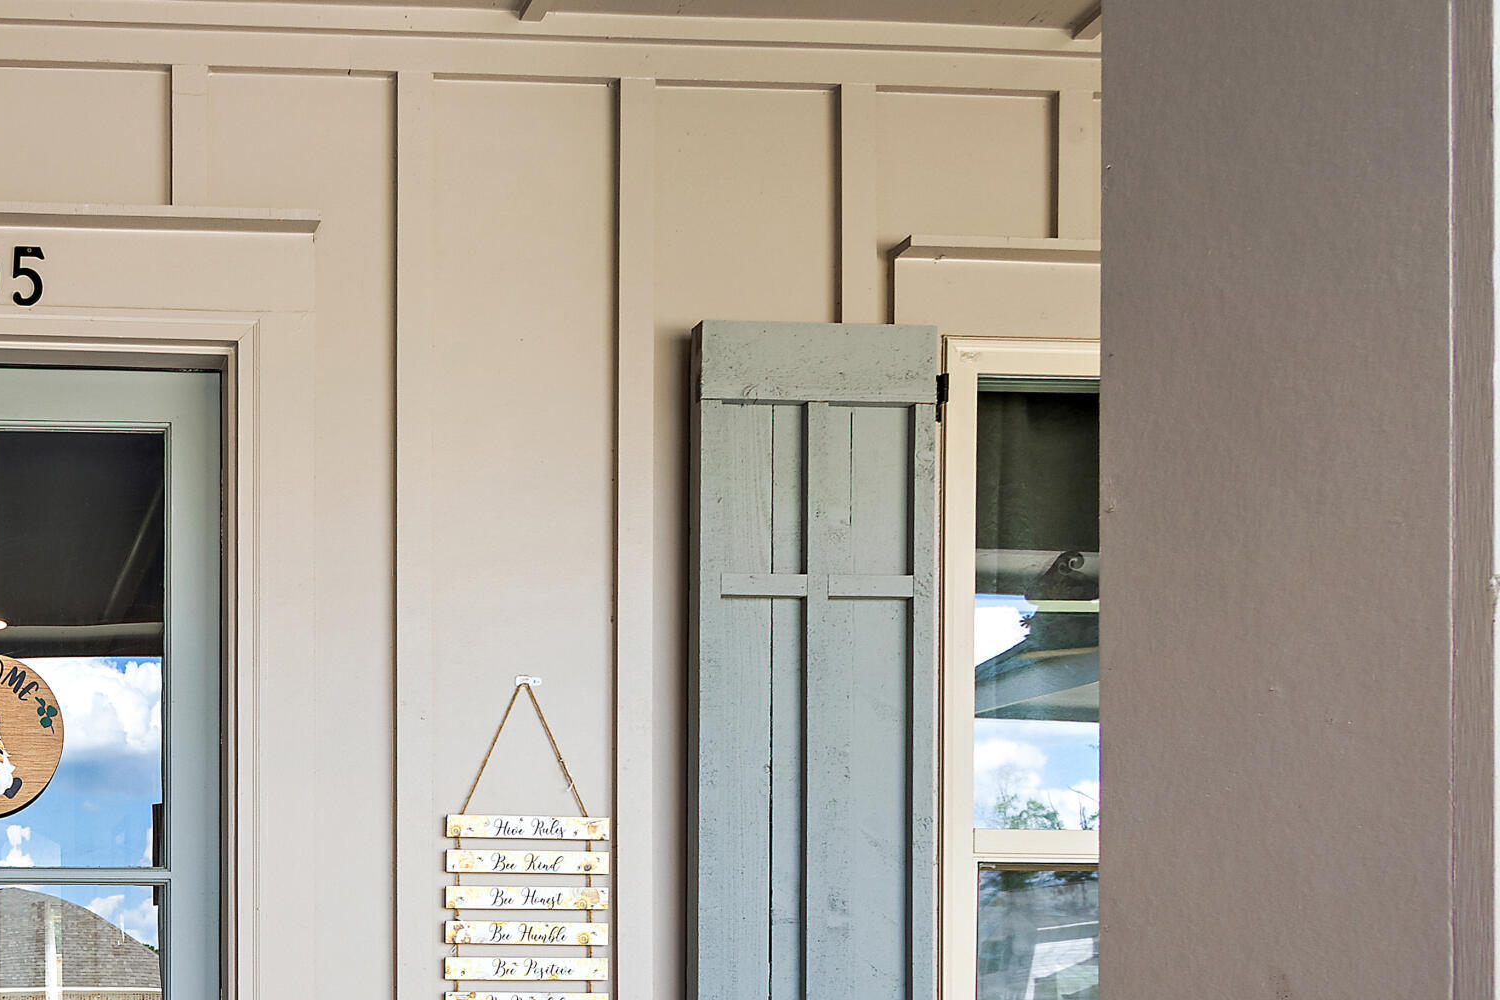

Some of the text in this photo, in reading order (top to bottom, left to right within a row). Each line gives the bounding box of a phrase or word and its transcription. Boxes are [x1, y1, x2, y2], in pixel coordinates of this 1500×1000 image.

[493, 818, 566, 838] Hive Rules
[490, 852, 564, 872] Bee Kind
[490, 887, 563, 909] Bee Honest
[488, 922, 568, 943] Bee Humble
[491, 957, 574, 979] Bee Positive
